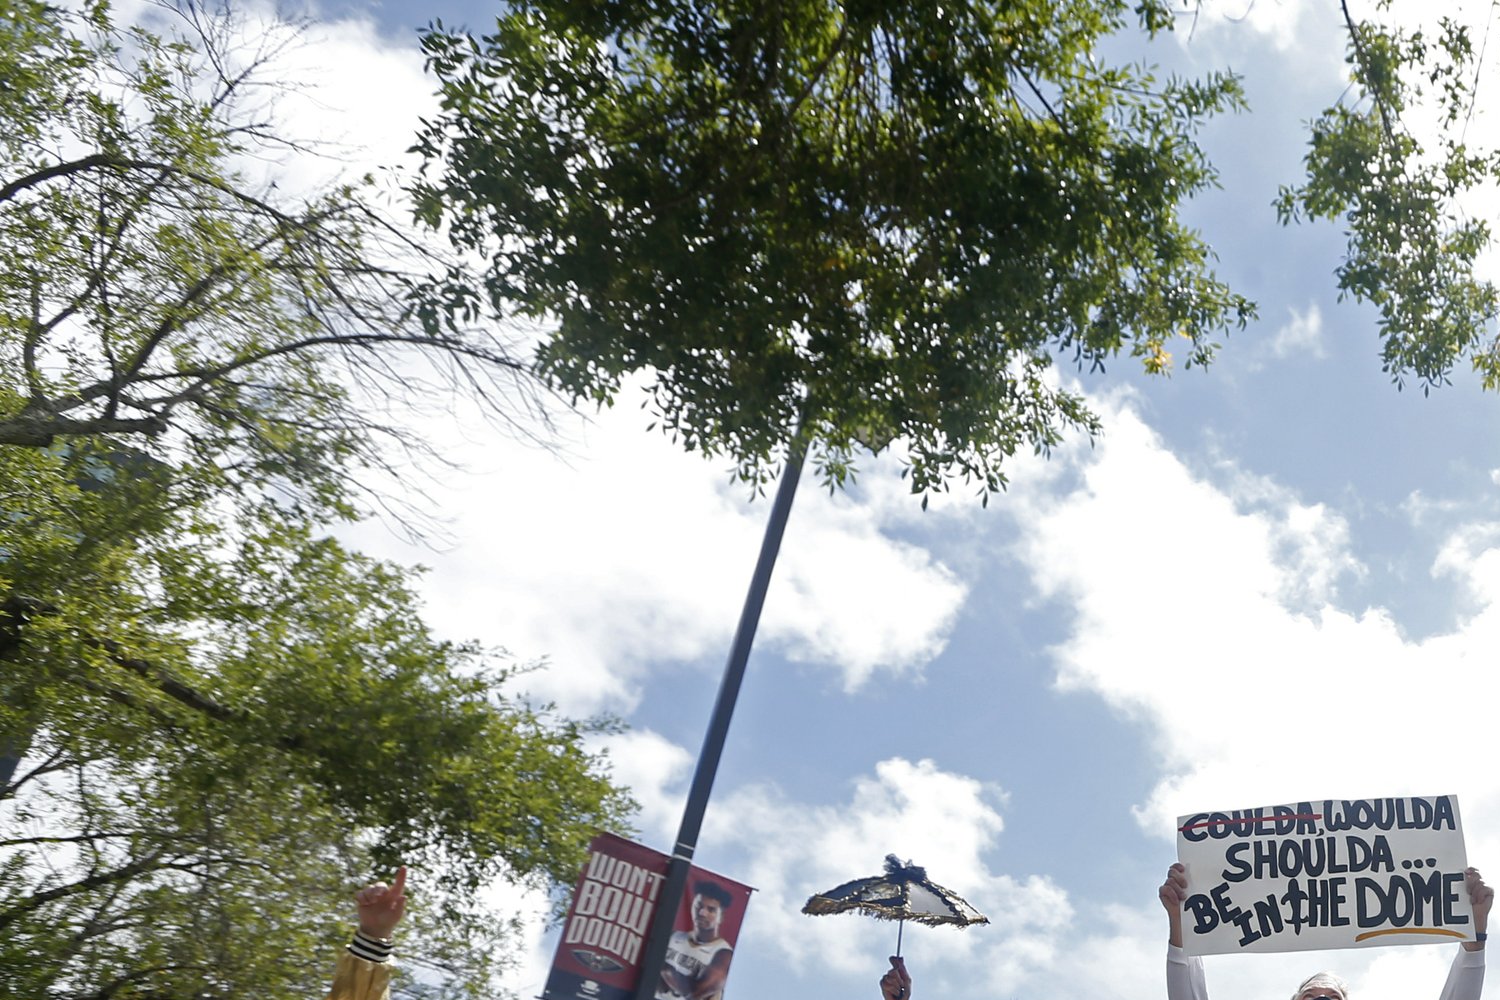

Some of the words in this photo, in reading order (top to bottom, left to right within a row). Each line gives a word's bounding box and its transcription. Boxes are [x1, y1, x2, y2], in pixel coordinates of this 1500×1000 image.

[1323, 795, 1456, 832] WOULDA
[586, 851, 666, 901] WON'T
[575, 880, 654, 935] BOW
[1184, 881, 1242, 935] BE
[1232, 893, 1284, 948] IN
[1356, 871, 1470, 929] DOME
[566, 916, 643, 965] DOWN
